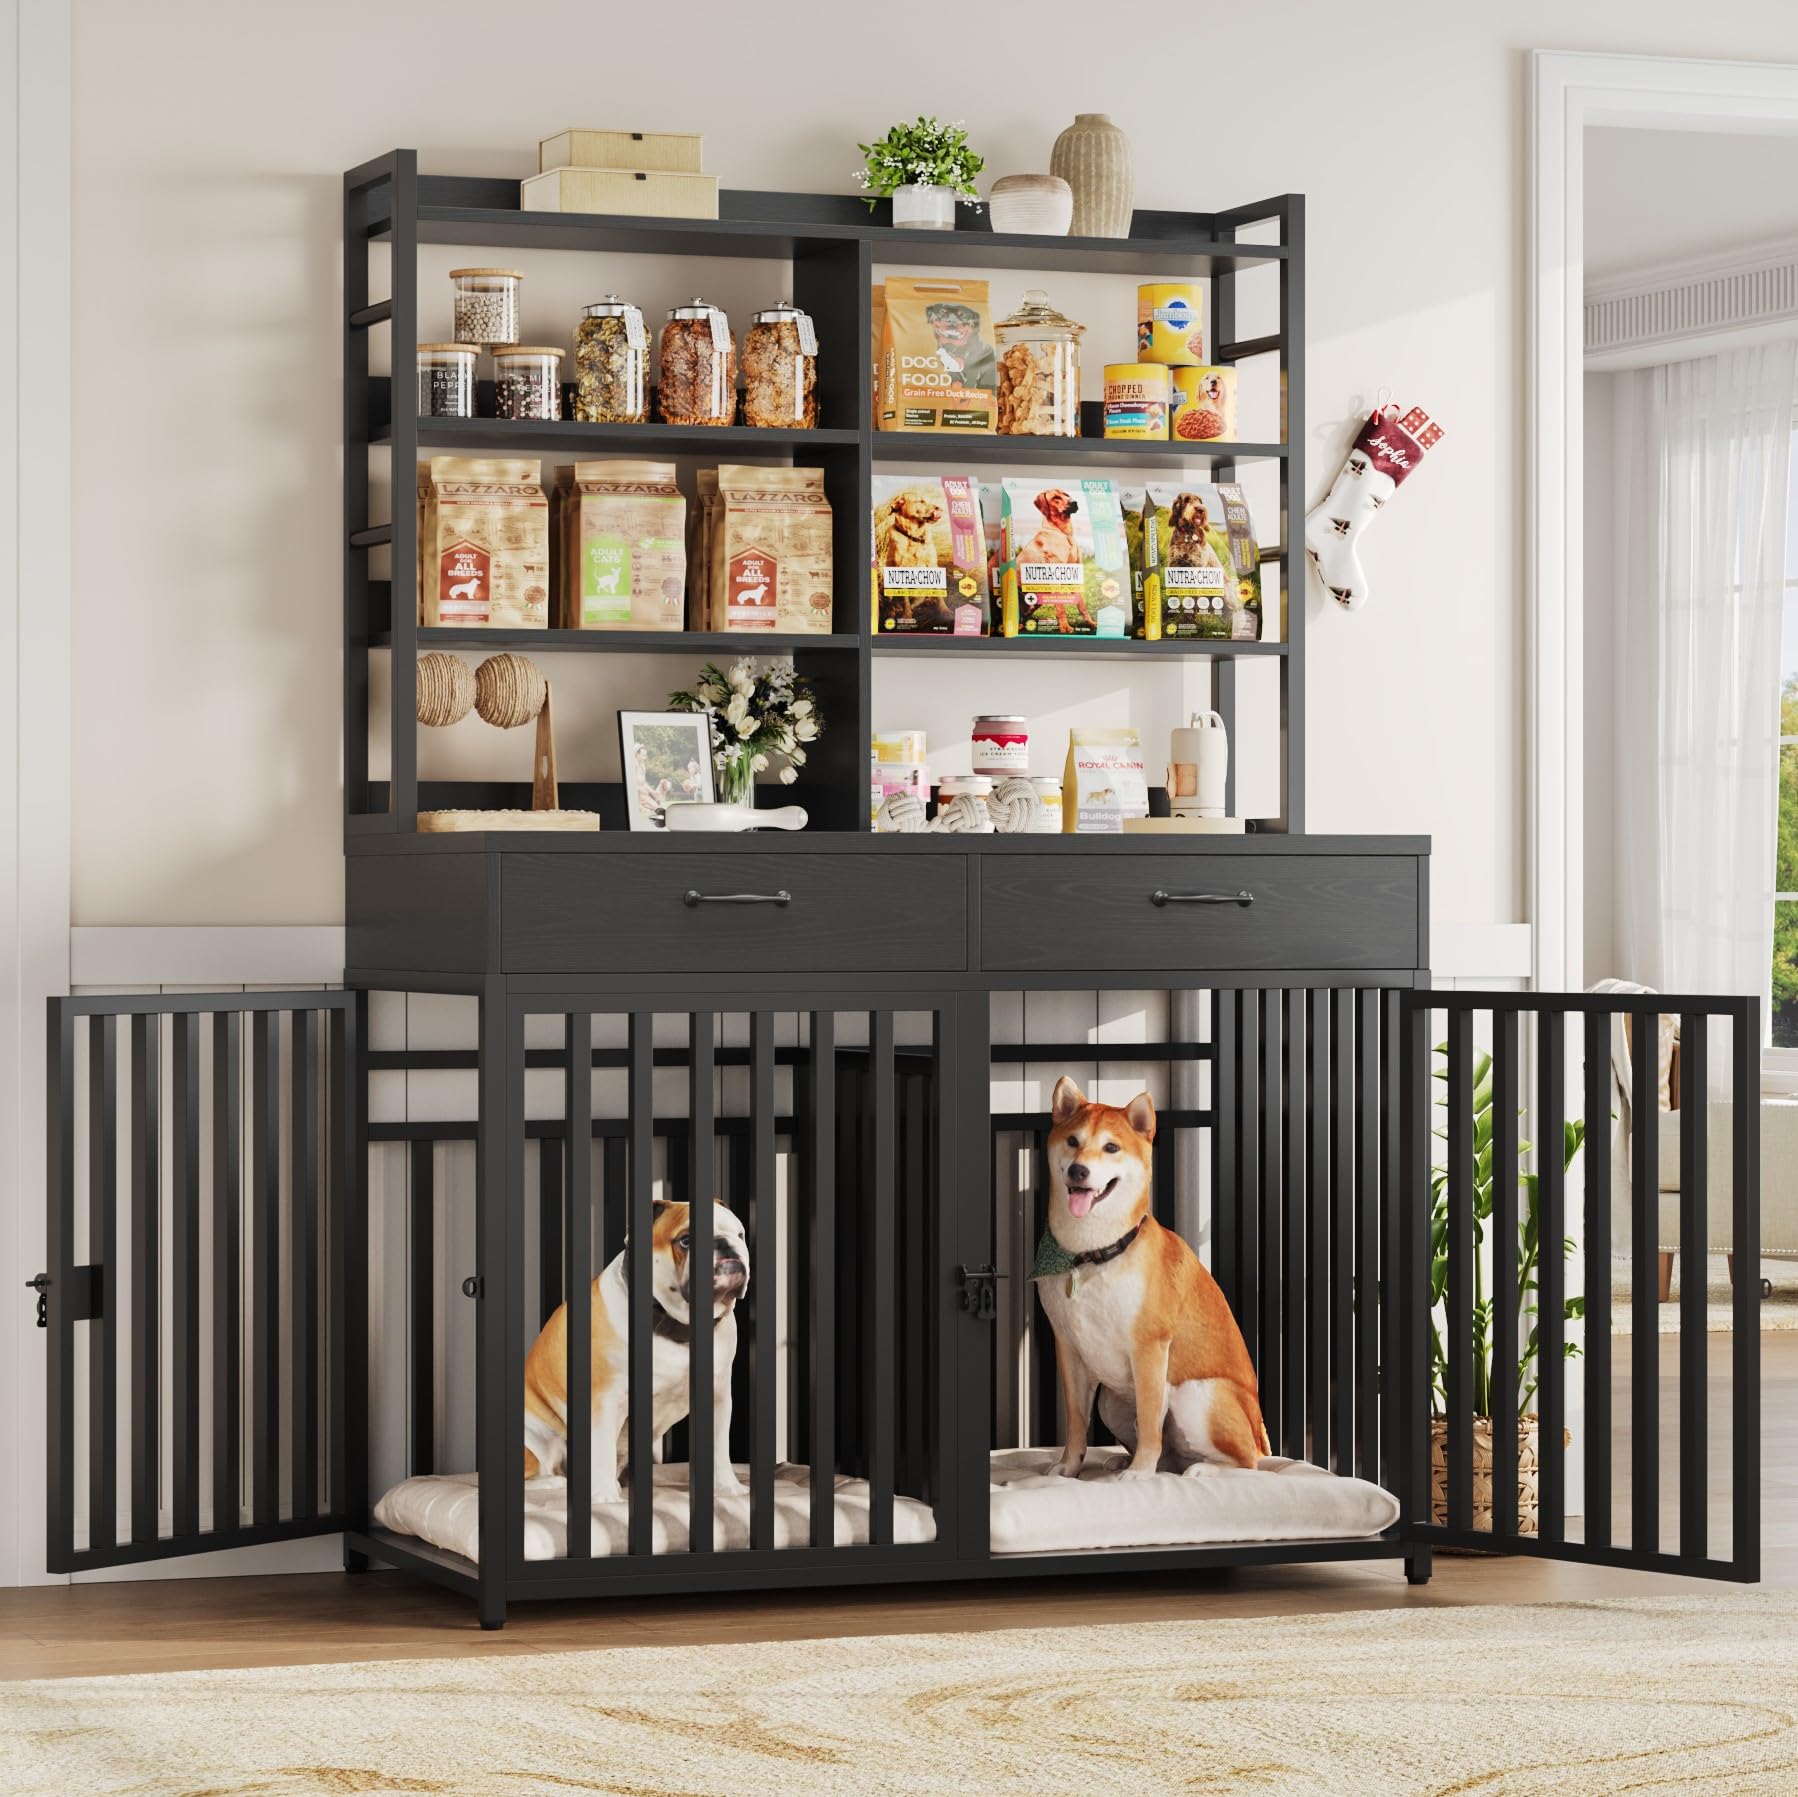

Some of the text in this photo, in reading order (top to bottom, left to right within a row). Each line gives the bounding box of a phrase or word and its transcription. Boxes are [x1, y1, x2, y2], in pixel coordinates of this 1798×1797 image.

[901, 355, 939, 369] DOG
[902, 373, 952, 387] FOOD
[903, 389, 989, 400] Grain Free Duck Recipe
[1109, 384, 1143, 394] CHOPPED
[442, 484, 539, 495] LAZZARO
[584, 484, 677, 495] LAZZARO
[730, 492, 823, 503] LAZZARO
[743, 569, 764, 577] ALL
[1079, 811, 1121, 821] Bulldog
